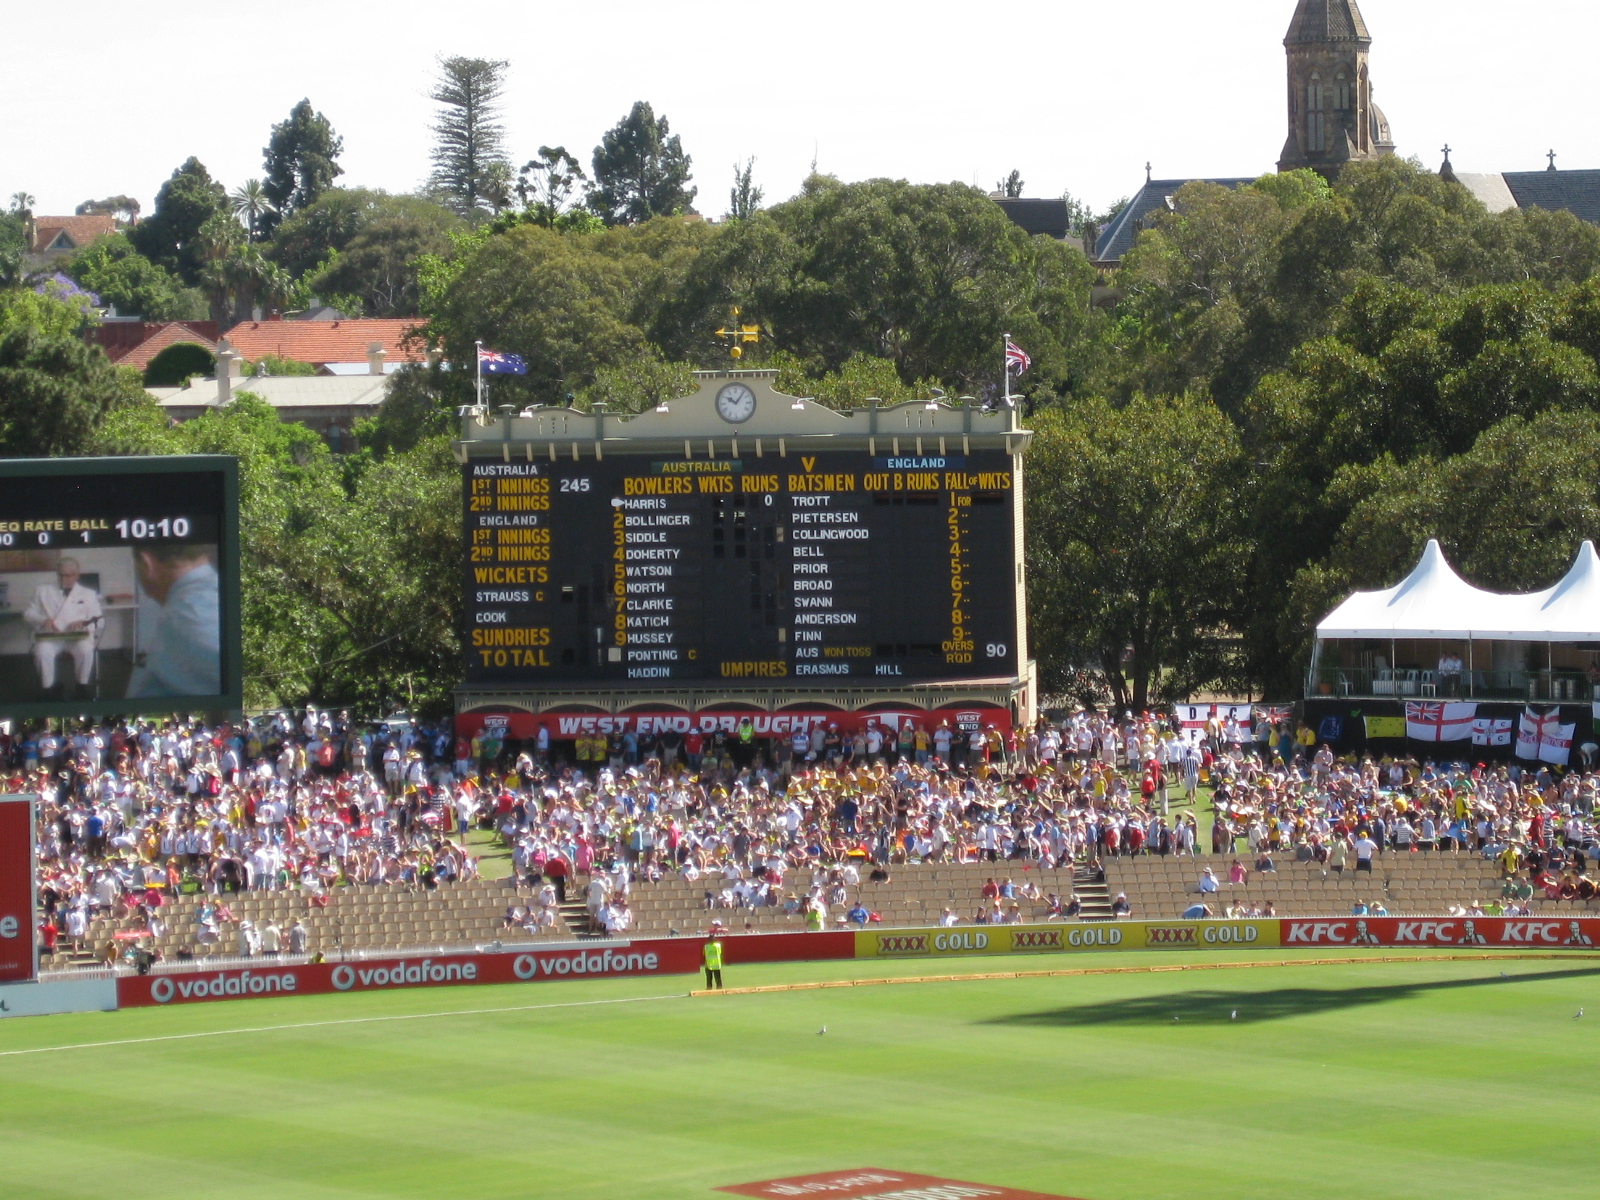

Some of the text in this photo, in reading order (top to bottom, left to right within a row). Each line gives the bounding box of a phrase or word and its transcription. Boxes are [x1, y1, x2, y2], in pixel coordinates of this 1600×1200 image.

[474, 465, 538, 476] AUSTRALIA
[662, 462, 732, 472] AUSTRALIA
[801, 457, 816, 472] V
[888, 458, 946, 468] ENGLAND
[472, 478, 550, 494] 1ST INNINGS
[560, 479, 590, 492] 245
[624, 475, 779, 496] BOWLERS WKTS RUNS
[788, 473, 940, 492] BATSMEN OUT B RUNS
[945, 472, 1011, 490] FALL OF WKTS
[470, 496, 550, 511] 2ND INNINGS
[624, 498, 667, 509] HARRIS
[764, 494, 772, 506] 0
[792, 496, 830, 506] TROTT
[958, 496, 972, 506] FOR
[480, 516, 537, 526] ENGLAND
[614, 514, 690, 528] 2 BOLLINGER
[792, 512, 858, 523] PIETERSEN
[948, 508, 958, 524] 2
[24, 521, 64, 532] RATE
[70, 520, 108, 530] BALL
[116, 518, 188, 538] 10:10
[792, 529, 868, 540] COLLINGWOOD
[949, 526, 959, 540] 3
[0, 531, 89, 546] 0 0 1
[473, 529, 550, 544] 1ST INNINGS
[614, 530, 666, 545] 3 SIDDLE
[471, 546, 550, 562] 2ND INNINGS
[614, 547, 680, 562] 4 DOHERTY
[793, 546, 824, 556] BELL
[950, 542, 960, 556] 4
[614, 564, 672, 578] 5 WATSON
[793, 564, 828, 574] PRIOR
[951, 558, 962, 574] 5
[474, 567, 548, 584] WICKETS
[951, 576, 962, 590] 6
[614, 580, 665, 595] 6 NORTH
[794, 580, 832, 590] BROAD
[476, 592, 544, 602] STRAUSS C
[614, 597, 673, 612] 7 CLARKE
[794, 597, 832, 608] SWANN
[952, 593, 962, 608] 7
[476, 612, 506, 622] COOK
[614, 614, 669, 630] 8 KATICH
[794, 614, 856, 624] ANDERSON
[952, 610, 962, 624] 8
[472, 628, 550, 646] SUNDRIES
[615, 631, 673, 646] 9 HUSSEY
[794, 631, 822, 641] FINN
[952, 627, 964, 641] 9
[796, 647, 872, 658] AUS WON TOSS
[942, 641, 974, 651] OVERS
[986, 644, 1006, 658] 90
[479, 650, 550, 667] TOTAL
[628, 650, 696, 661] PONTING C
[628, 668, 670, 678] HADDIN
[721, 661, 787, 678] UMPIRES
[796, 664, 902, 675] ERASMUS HILL
[559, 716, 827, 734] WEST END DRAUGHT
[1014, 928, 1122, 947] XXXX GOLD
[1150, 925, 1258, 943] XXXX GOLD
[1288, 922, 1347, 942] KFC
[1394, 922, 1454, 942] KFC
[1501, 922, 1560, 942] KFC
[881, 932, 988, 951] XXXX GOLD
[540, 950, 658, 976] vodafone
[358, 959, 477, 986] vodafone
[178, 971, 296, 998] vodafone
